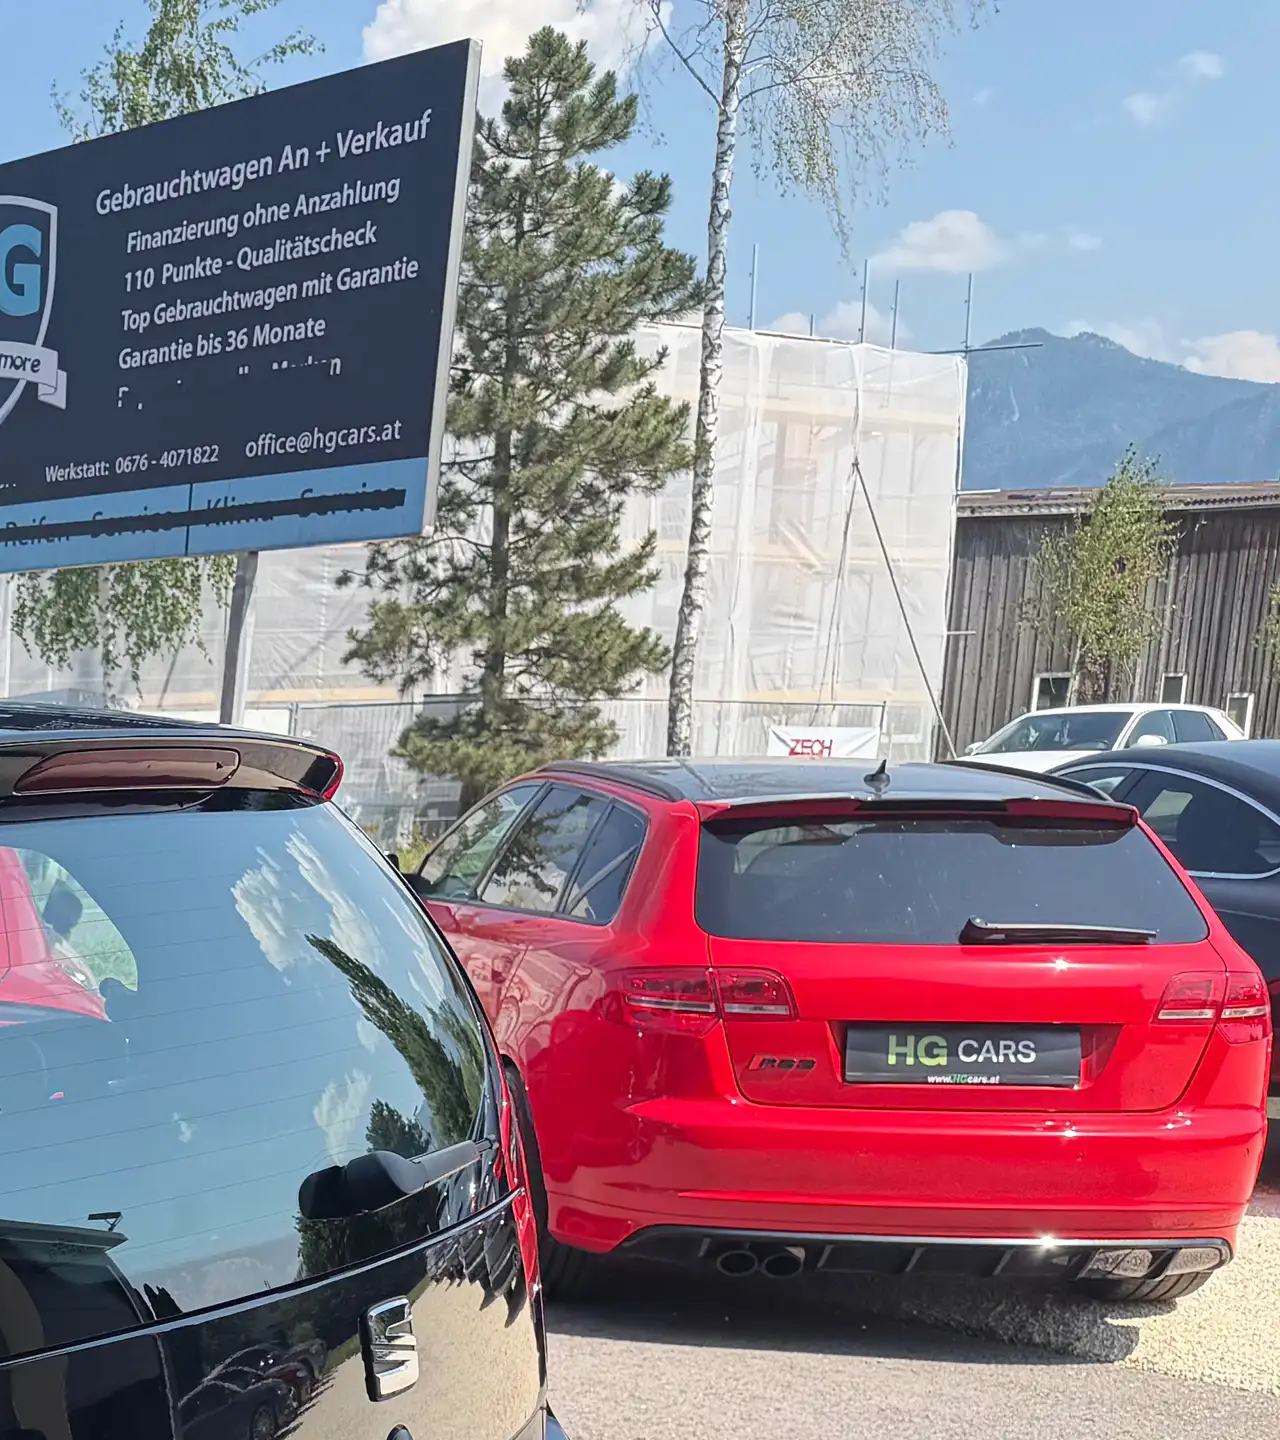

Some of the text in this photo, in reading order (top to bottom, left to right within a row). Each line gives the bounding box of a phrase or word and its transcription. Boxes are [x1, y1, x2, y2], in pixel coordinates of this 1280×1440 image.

[95, 108, 433, 216] Gebrauchtwagen An + Verkauf
[126, 177, 401, 254] Finanzierung ohne Anzahlung
[124, 267, 155, 292] 110
[161, 255, 223, 285] Punkte
[236, 220, 378, 271] Qualitätscheck
[121, 256, 420, 334] Top Gebrauchtwagen mit Garantie
[118, 317, 327, 370] Garantie bis 36 Monate
[245, 419, 402, 458] office@hgcars.at
[45, 460, 110, 483] Werkstatt:
[115, 453, 149, 475] 0676
[159, 444, 219, 469] 4071822
[789, 738, 833, 757] ZECH
[886, 1033, 1037, 1067] HG CARS
[927, 1073, 1000, 1085] www.HGcars.at
